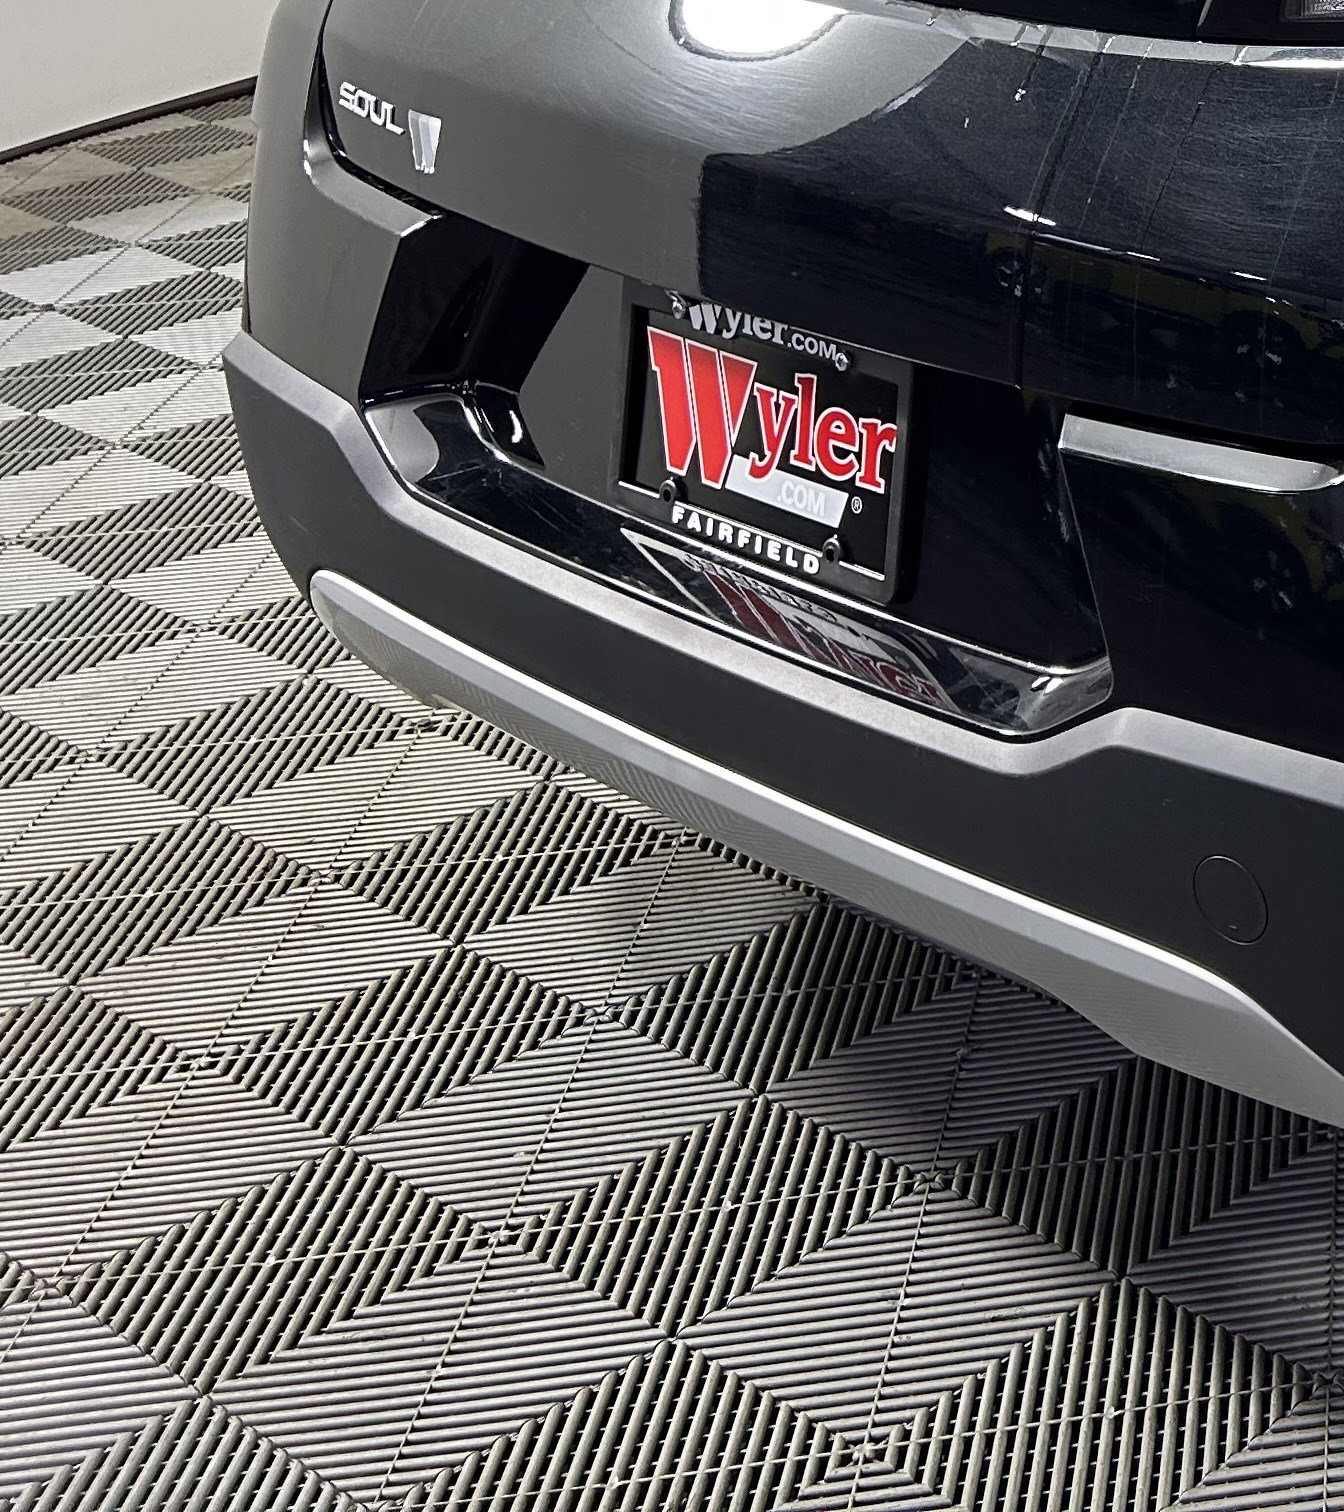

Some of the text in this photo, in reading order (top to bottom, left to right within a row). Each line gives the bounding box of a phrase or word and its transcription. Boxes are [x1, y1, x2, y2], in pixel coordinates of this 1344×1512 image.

[338, 81, 405, 135] SOUL
[647, 325, 897, 494] Wyler
[672, 506, 820, 575] FAIRFIELD
